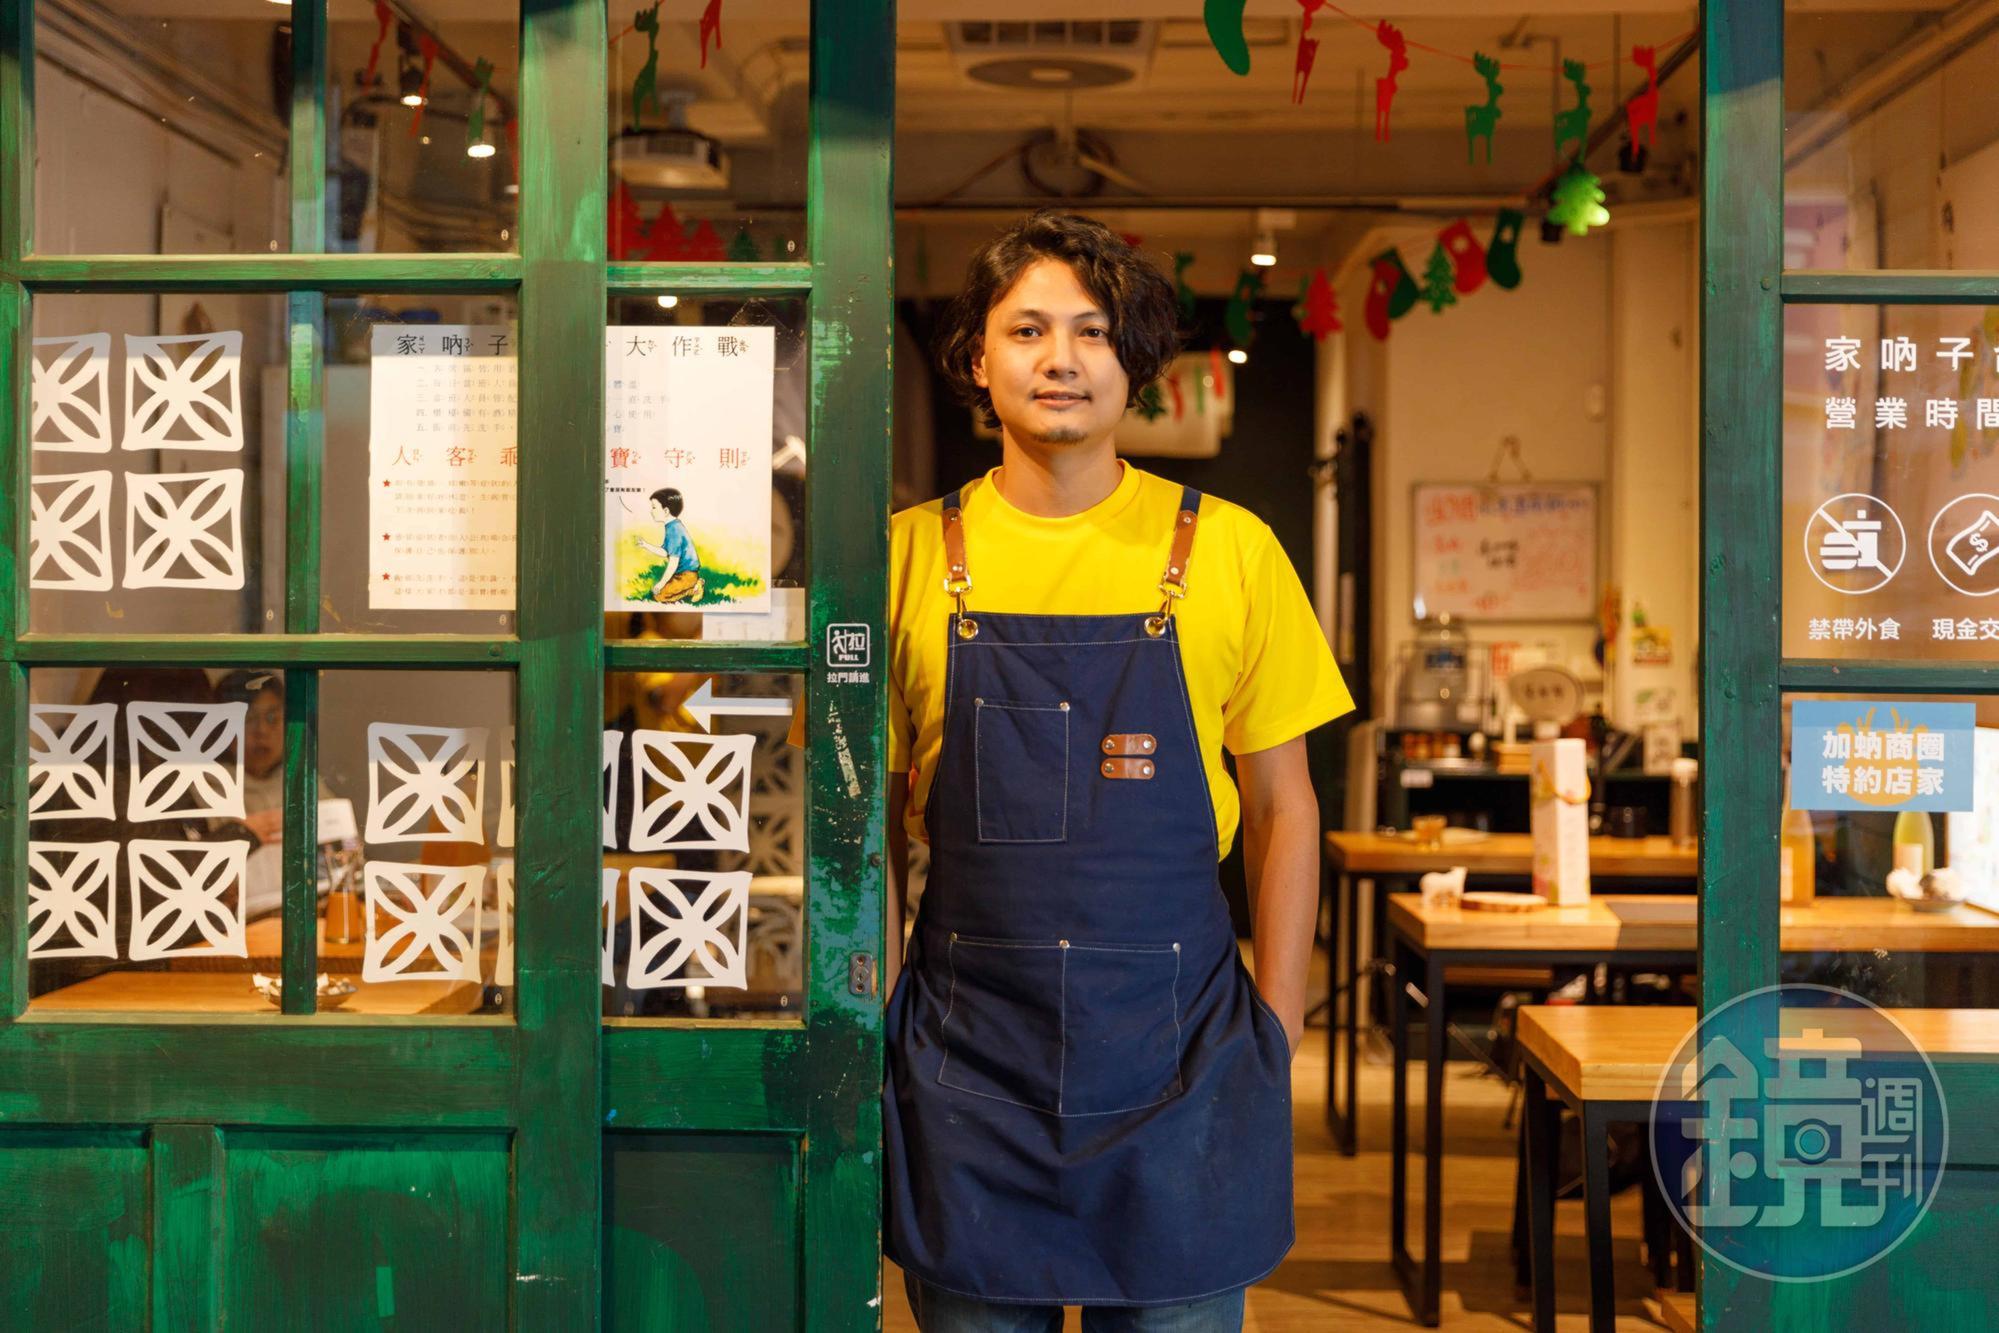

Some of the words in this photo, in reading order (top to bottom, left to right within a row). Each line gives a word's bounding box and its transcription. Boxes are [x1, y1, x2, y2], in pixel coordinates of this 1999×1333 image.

[1825, 396, 1999, 430] 營業時間
[1808, 617, 1901, 640] 禁帶外食
[1931, 618, 1999, 641] 現金交
[1822, 731, 1945, 762] 加蚋商圈
[1821, 765, 1944, 796] 特約店家
